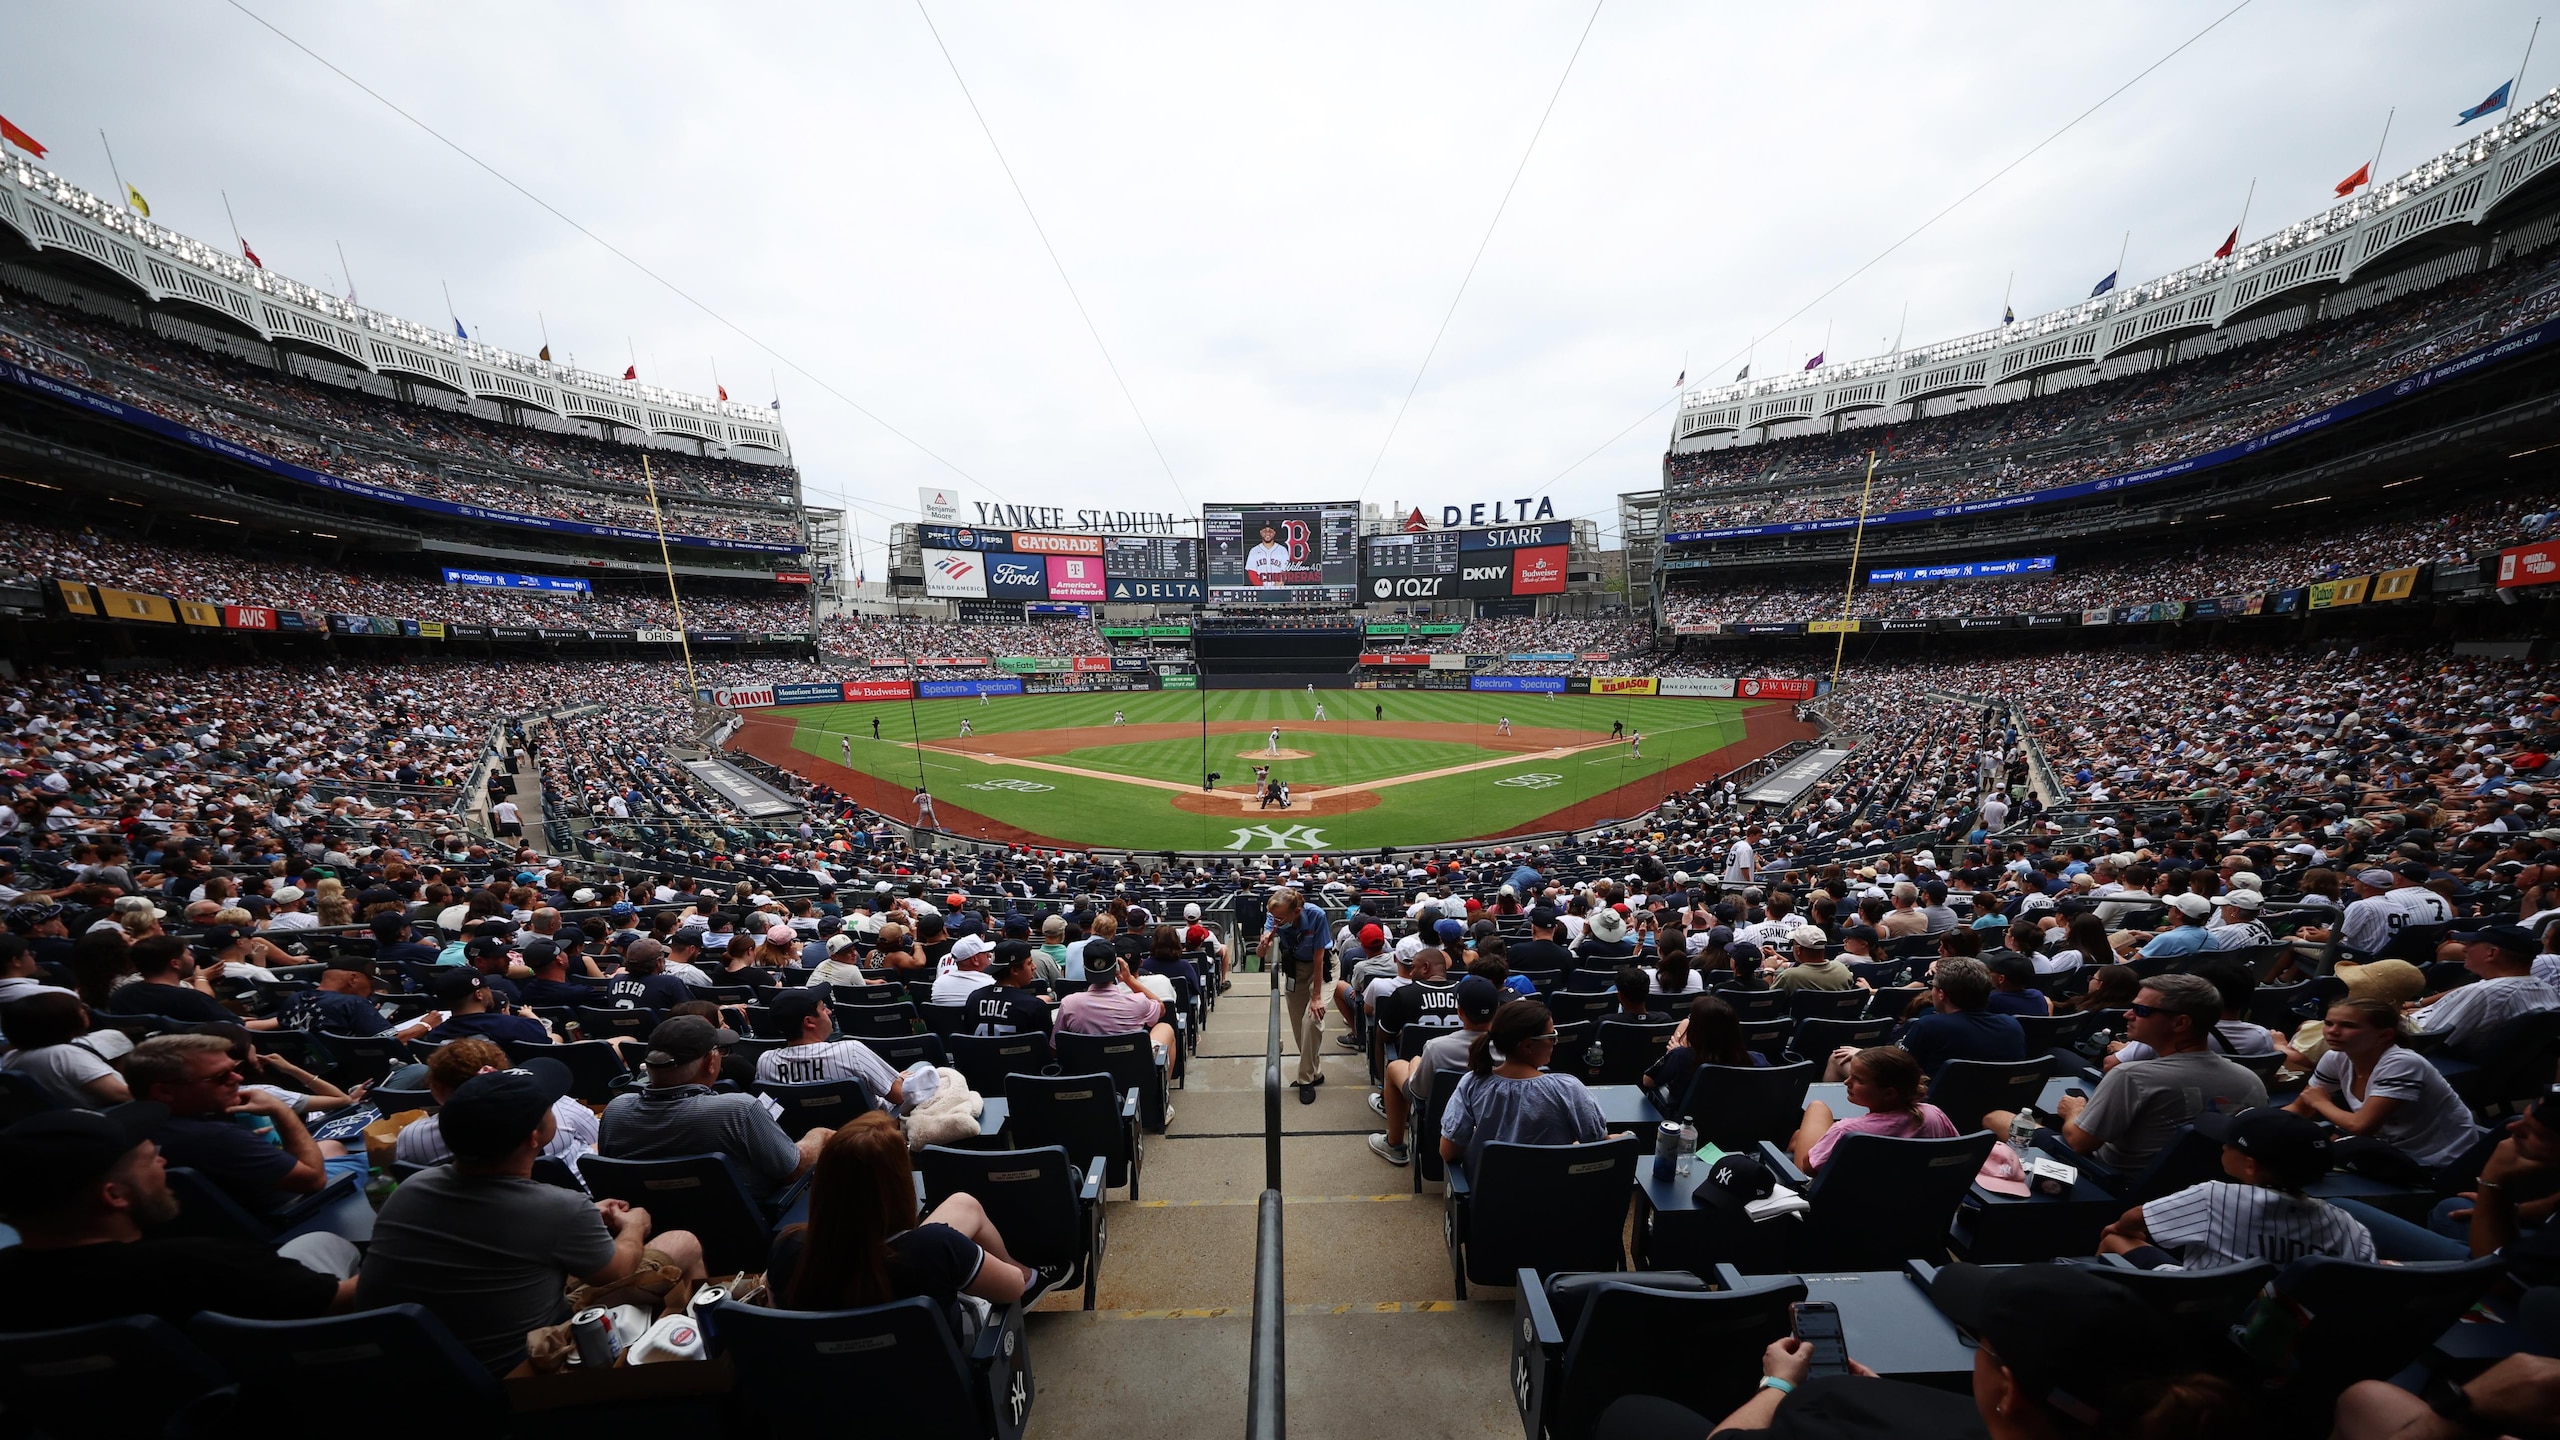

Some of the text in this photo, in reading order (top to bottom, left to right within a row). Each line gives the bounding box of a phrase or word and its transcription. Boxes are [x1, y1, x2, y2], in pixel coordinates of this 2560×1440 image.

[2451, 353, 2486, 373] EXPLORER
[2493, 340, 2524, 356] OFFICIAL
[927, 504, 956, 513] Benjamin
[1444, 496, 1554, 527] DELTA
[973, 501, 1174, 534] YANKEE STADIUM
[1017, 535, 1098, 552] GATORADE
[1487, 527, 1542, 547] STARR
[462, 573, 492, 583] roadway
[993, 563, 1039, 585] Ford
[1463, 566, 1508, 580] DKNY
[1929, 567, 1960, 576] roadway
[1136, 584, 1200, 597] DELTA
[1396, 577, 1442, 597] razr
[239, 608, 266, 627] AVIS
[645, 632, 673, 641] ORIS
[778, 688, 811, 696] Montefiore
[864, 688, 910, 696] Budweiser
[924, 685, 964, 694] Spectrum
[976, 683, 1014, 693] Spectrum
[1475, 679, 1509, 689] Spectrum
[1520, 679, 1558, 689] Spectrum
[1762, 682, 1808, 691] F.W. WEBB
[715, 690, 773, 707] Canon
[1224, 824, 1332, 850] NY
[2425, 899, 2444, 921] 7
[612, 980, 645, 998] JETER
[979, 1000, 1012, 1019] COLE
[777, 1059, 823, 1084] RUTH
[1716, 1167, 1733, 1185] NY
